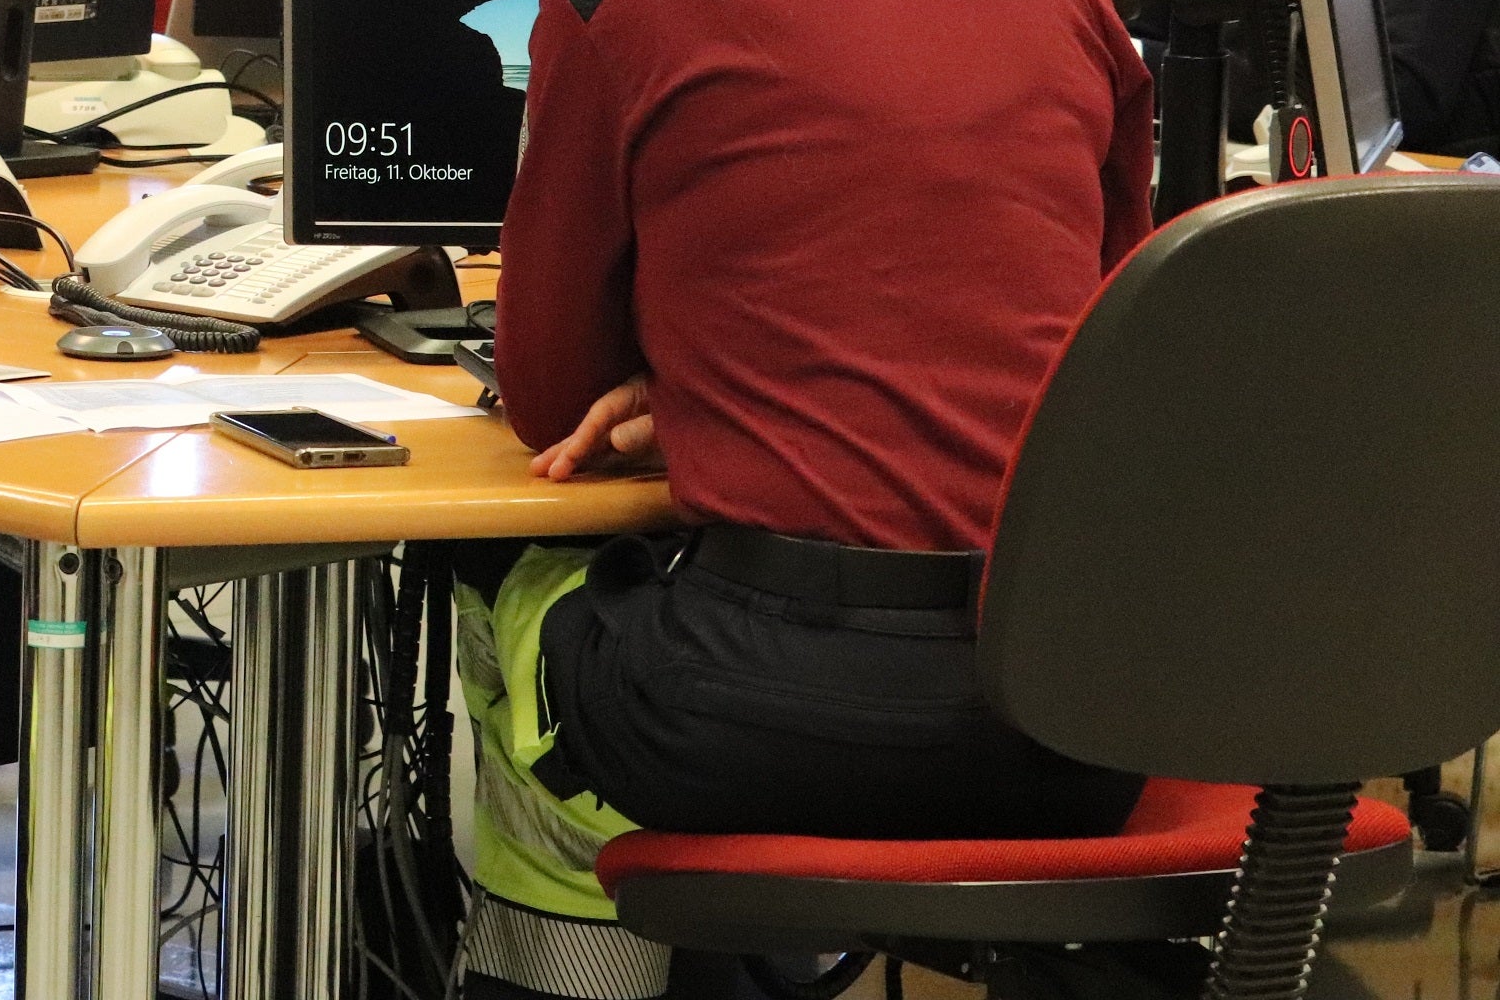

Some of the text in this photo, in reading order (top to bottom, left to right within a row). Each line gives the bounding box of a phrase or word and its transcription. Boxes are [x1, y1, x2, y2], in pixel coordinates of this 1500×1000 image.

[325, 121, 413, 157] 09:51
[324, 163, 474, 185] Freitag, 11. Oktober
